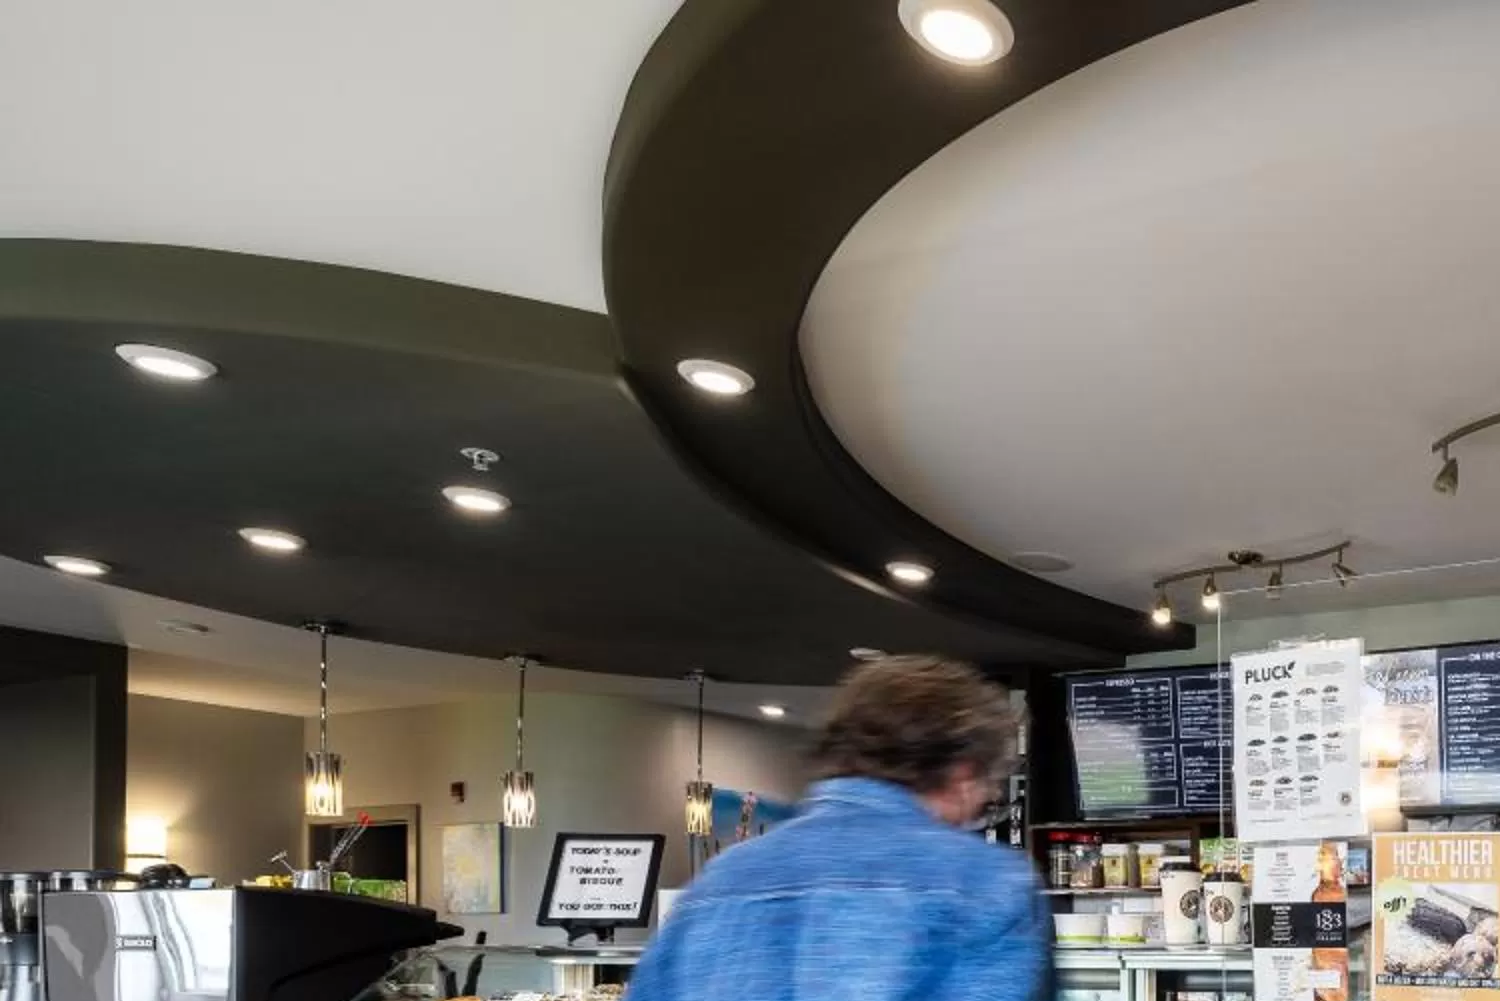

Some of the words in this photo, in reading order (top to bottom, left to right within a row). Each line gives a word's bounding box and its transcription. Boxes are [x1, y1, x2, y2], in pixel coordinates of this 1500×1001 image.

[1245, 664, 1292, 684] PLUCK
[613, 847, 642, 856] SOUP
[1393, 839, 1493, 865] HEALTHIER
[569, 866, 616, 875] TOMATO
[1315, 909, 1343, 931] 183
